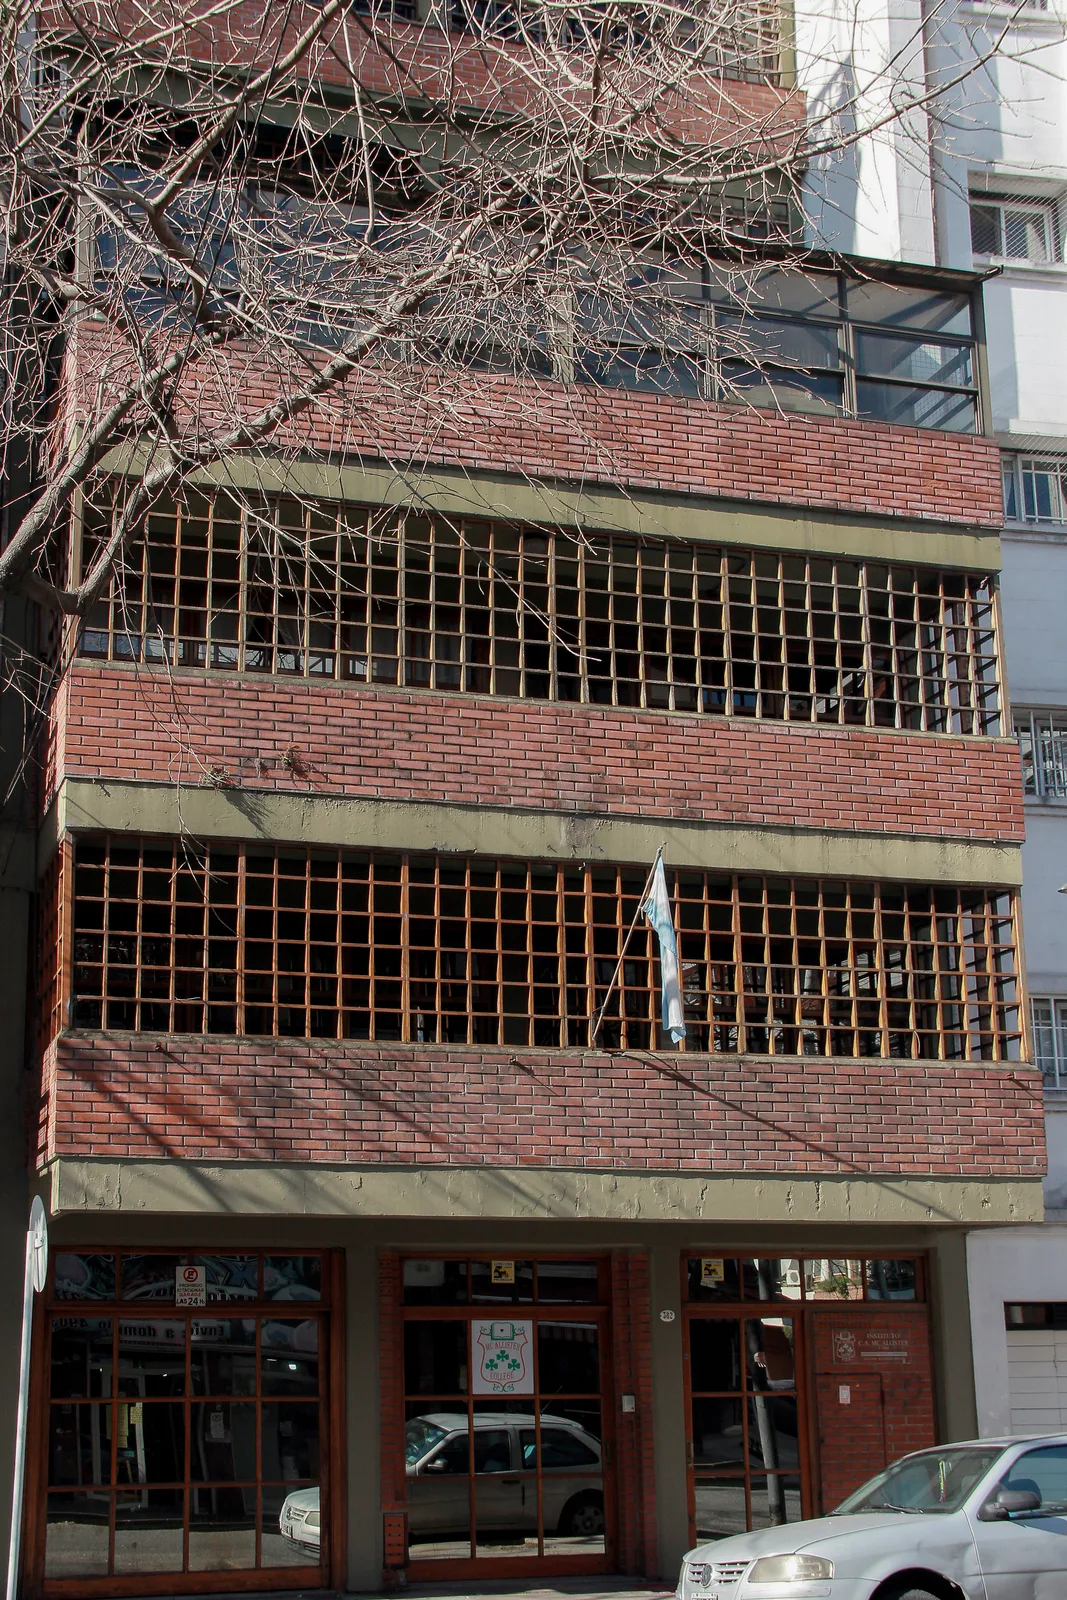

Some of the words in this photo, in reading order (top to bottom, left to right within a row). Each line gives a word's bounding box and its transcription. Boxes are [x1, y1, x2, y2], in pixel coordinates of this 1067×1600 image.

[187, 1297, 199, 1306] 24
[495, 1341, 520, 1351] ALLISTER
[490, 1371, 515, 1381] COLLEGE
